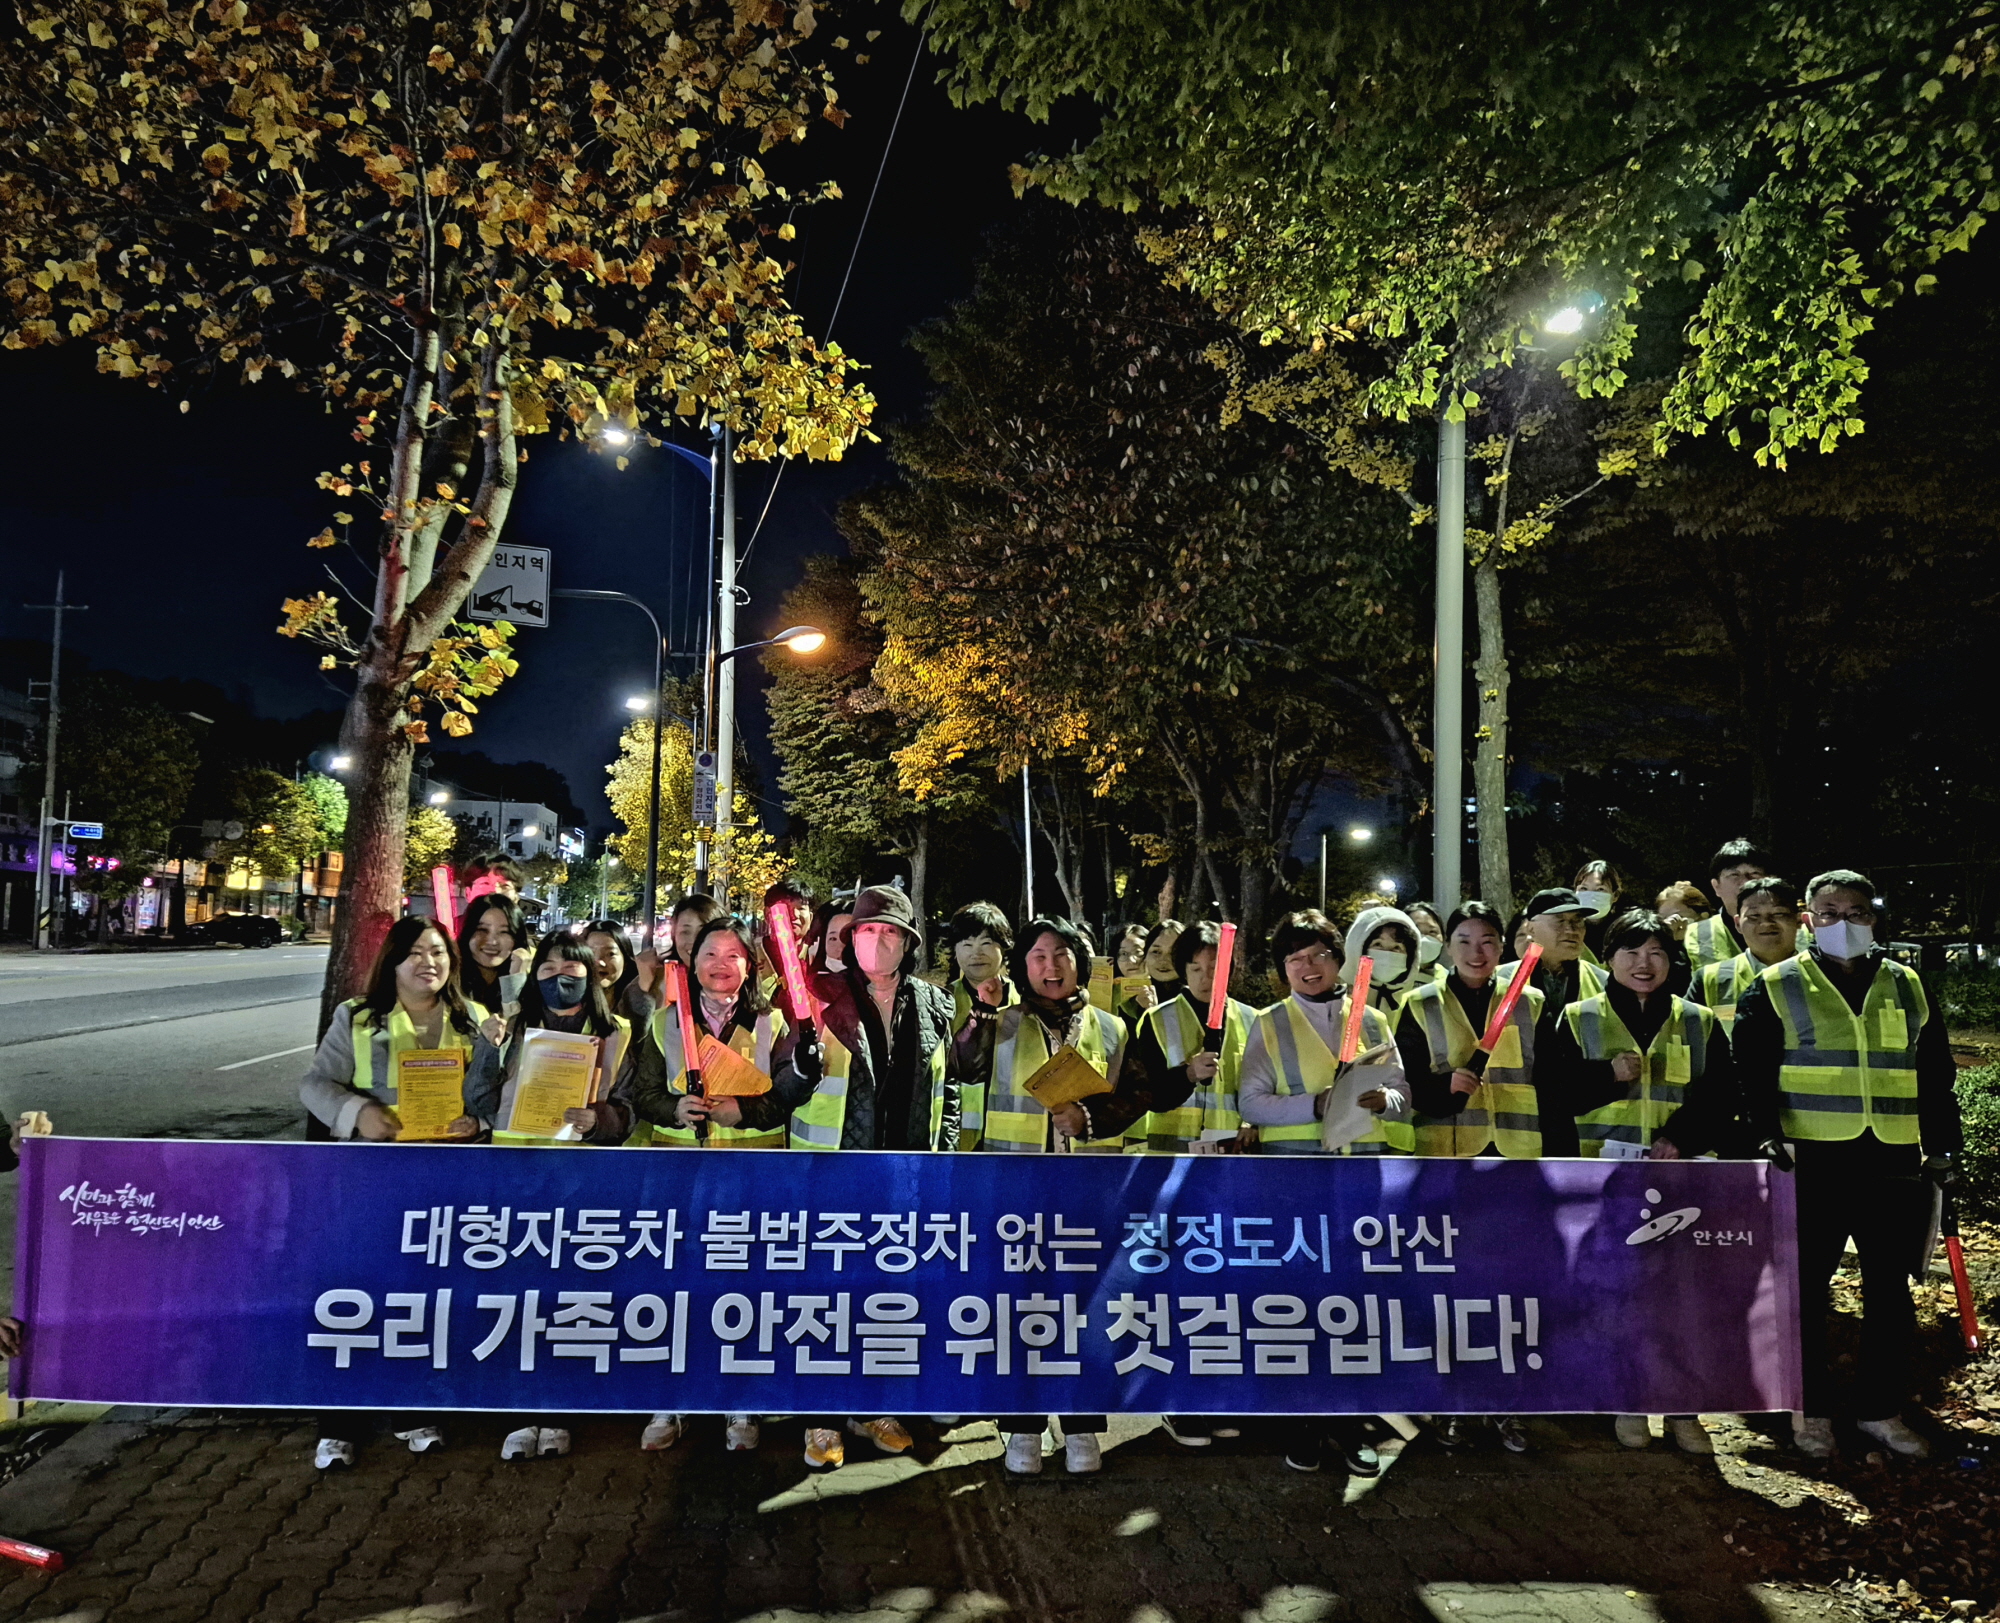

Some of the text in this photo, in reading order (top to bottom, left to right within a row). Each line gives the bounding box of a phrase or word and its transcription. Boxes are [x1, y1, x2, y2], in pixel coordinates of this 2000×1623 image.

[486, 552, 544, 573] 인지역
[401, 1205, 1459, 1274] 대형자동차 불법주정차 없는 청정도시 안산
[1692, 1229, 1753, 1246] 안산시
[307, 1288, 1543, 1376] 우리 가족의 안전을 위한 첫걸음입니다!
